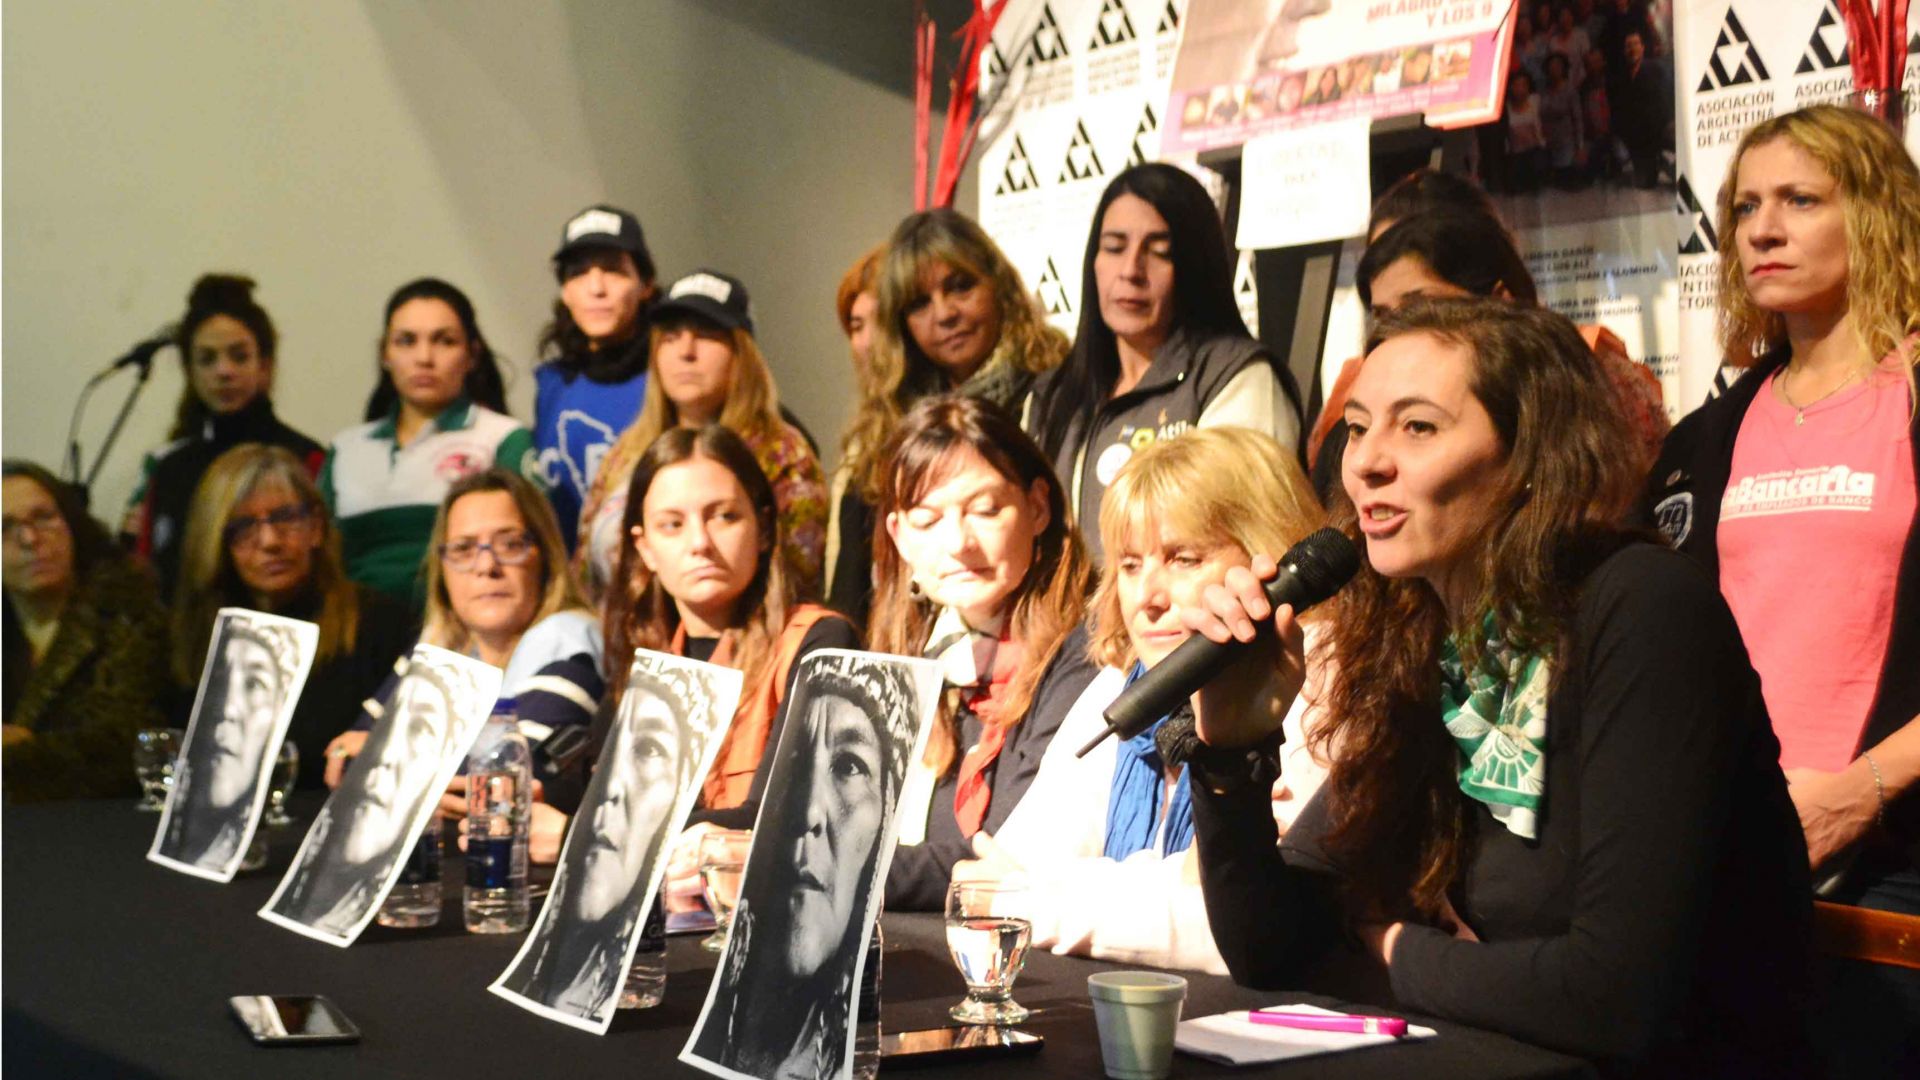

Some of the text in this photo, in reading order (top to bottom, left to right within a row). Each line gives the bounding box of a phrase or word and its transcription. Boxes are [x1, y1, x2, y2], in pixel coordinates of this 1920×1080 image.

[1697, 88, 1775, 116] ASOCIACIÓN
[1697, 107, 1775, 132] ARGENTINA
[1719, 129, 1740, 144] ACT
